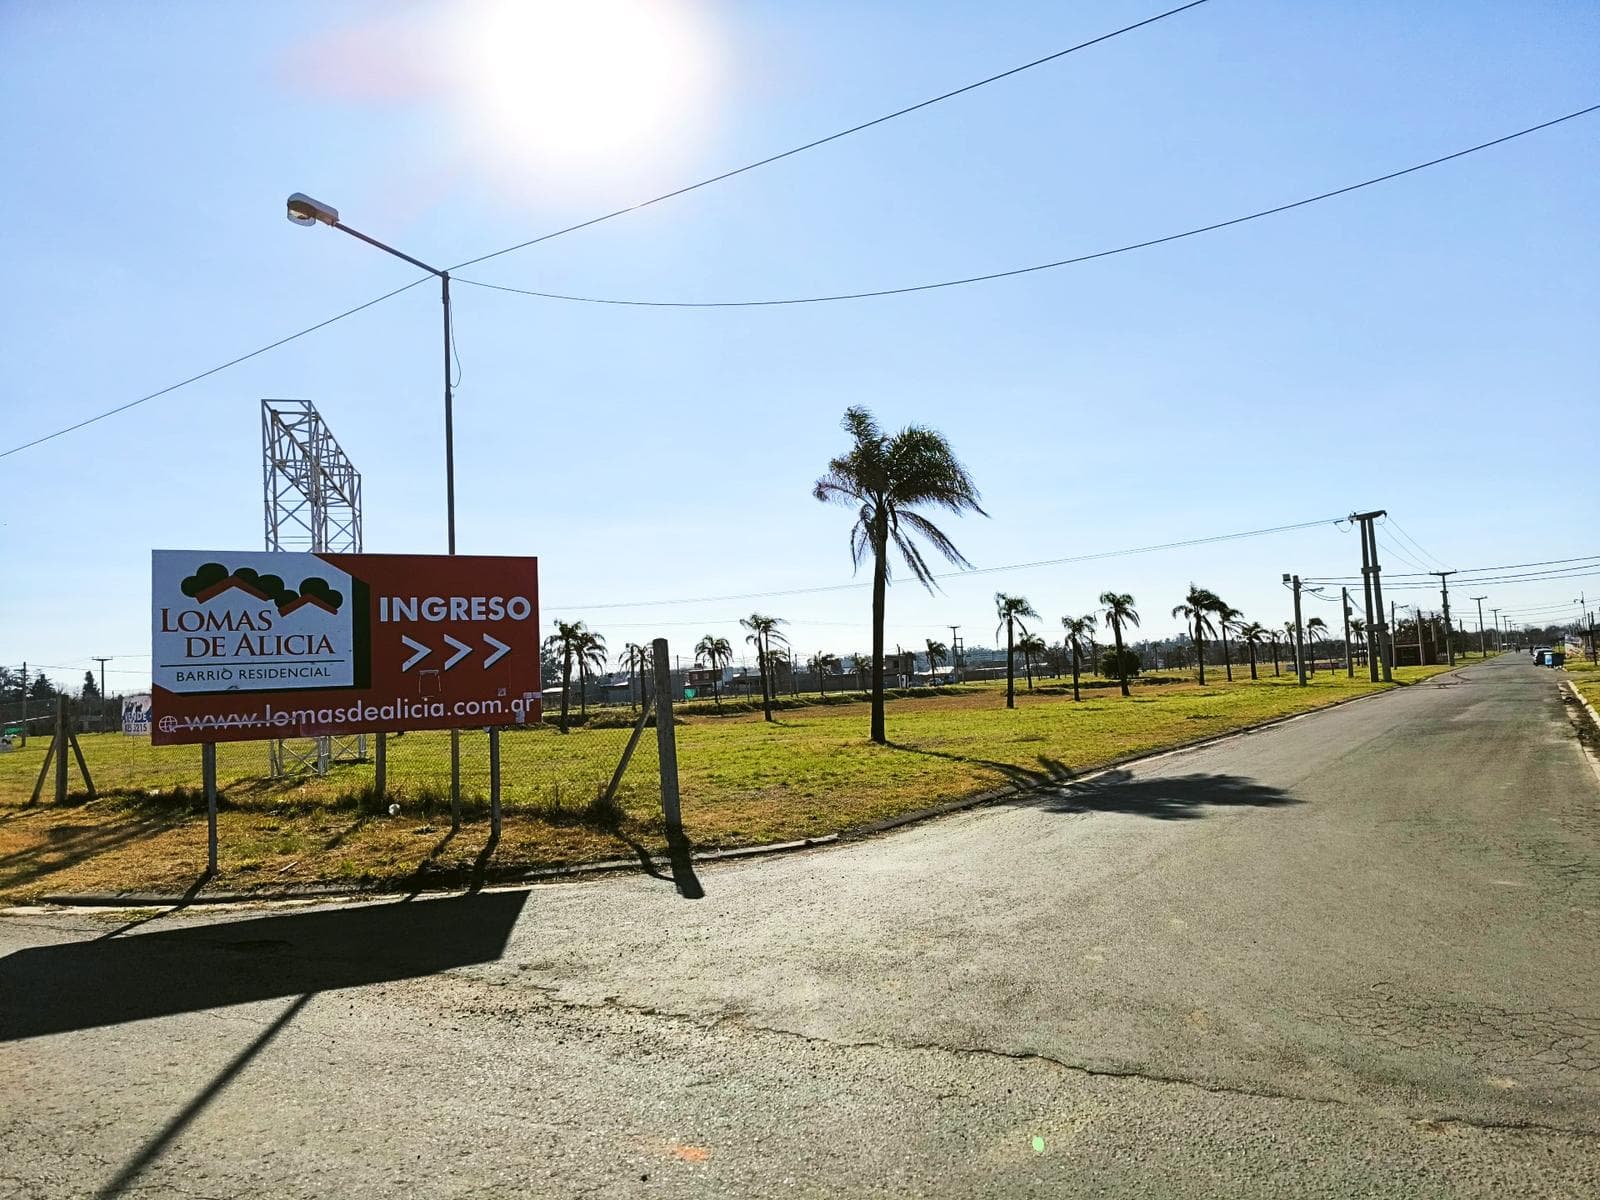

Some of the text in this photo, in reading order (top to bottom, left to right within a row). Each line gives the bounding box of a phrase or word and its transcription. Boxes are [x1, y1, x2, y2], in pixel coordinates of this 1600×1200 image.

[160, 607, 273, 633] LOMAS
[379, 596, 531, 622] INGRESO
[185, 632, 335, 658] DE ALICIA
[238, 666, 331, 680] RESIDENCIAL
[184, 697, 534, 731] www.lomasdealicia.com.ar
